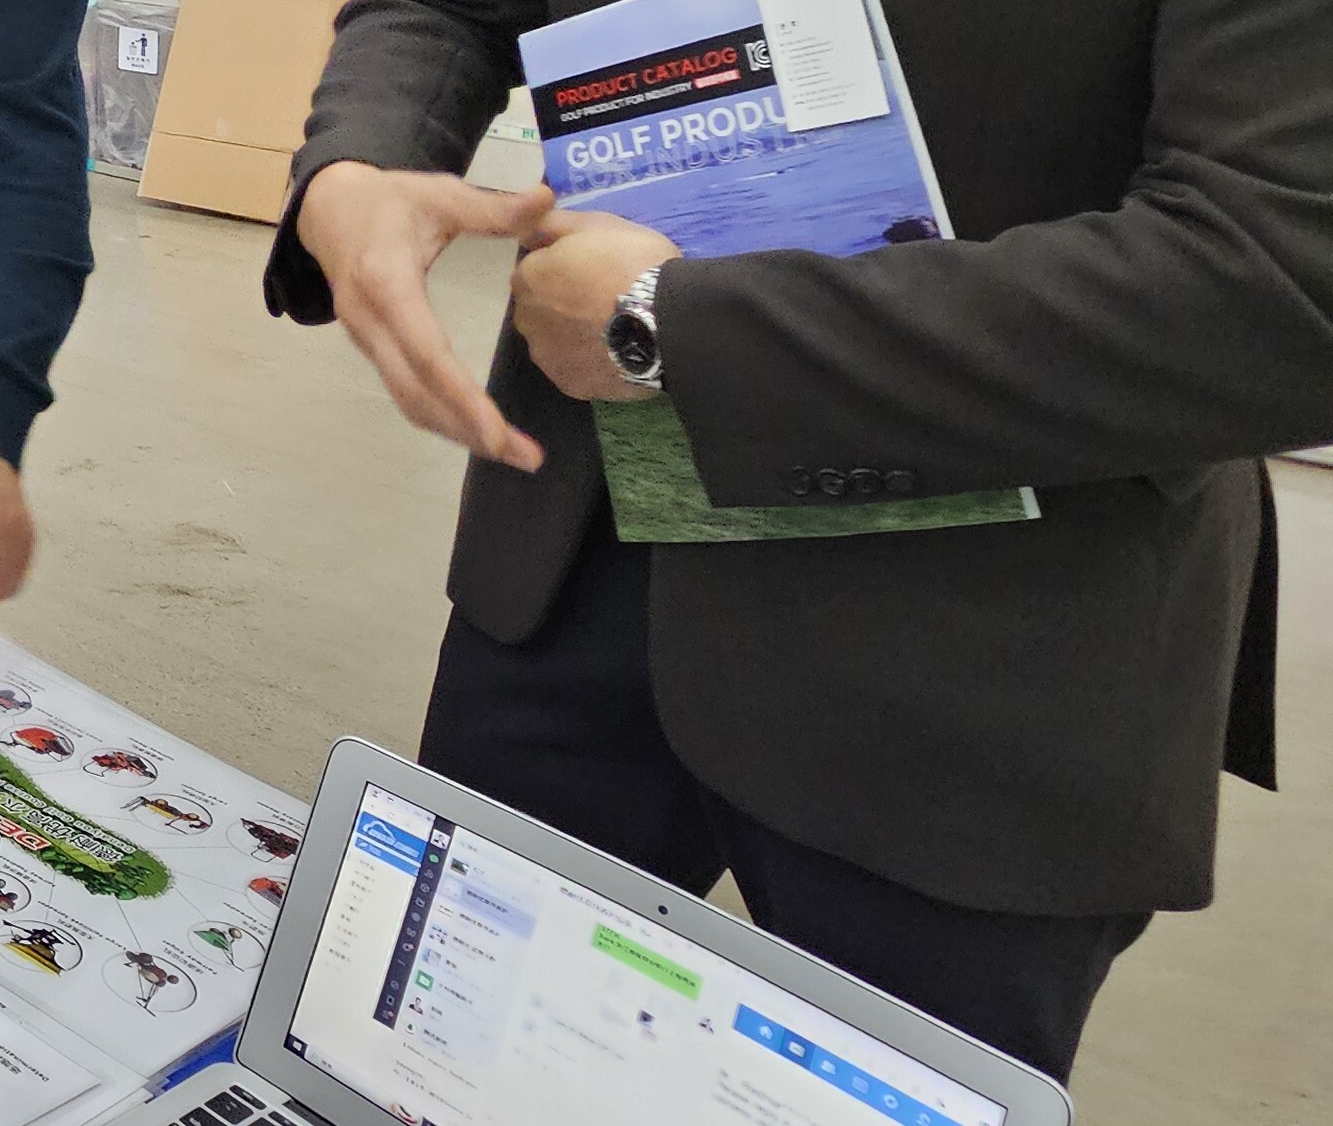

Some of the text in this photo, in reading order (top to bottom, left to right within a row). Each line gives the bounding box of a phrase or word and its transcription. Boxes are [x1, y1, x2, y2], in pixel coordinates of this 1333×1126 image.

[554, 72, 638, 108] PRODUCT
[642, 46, 739, 85] CATALOG
[560, 82, 692, 123] GOLF PRODUCT FOR INDUSTRY
[566, 124, 652, 169] GOLF
[0, 781, 48, 810] Course
[41, 804, 76, 824] Golf
[71, 819, 137, 854] Denaiyou
